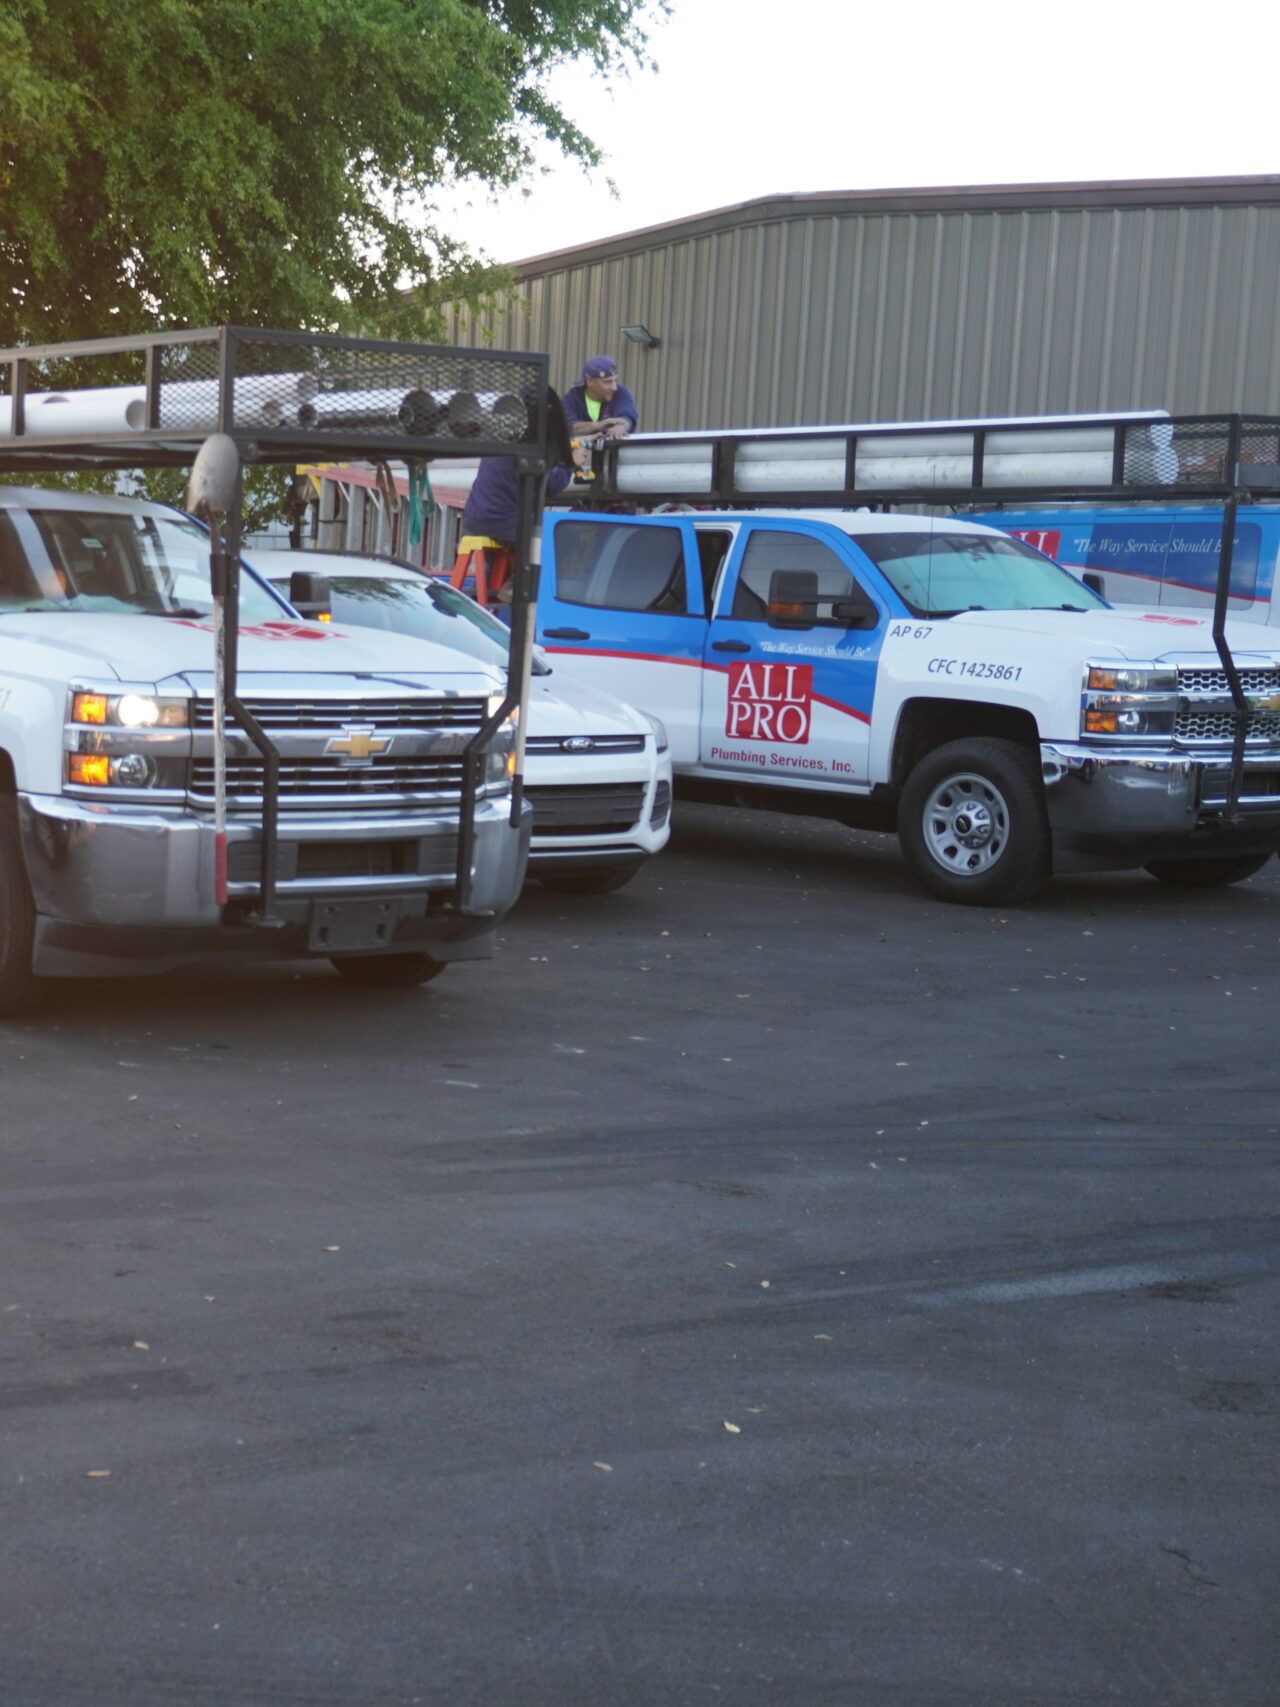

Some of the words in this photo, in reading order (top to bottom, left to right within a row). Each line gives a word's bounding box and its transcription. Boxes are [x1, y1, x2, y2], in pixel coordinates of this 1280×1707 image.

[1099, 538, 1123, 556] Way
[1125, 538, 1168, 553] Service
[1170, 538, 1213, 553] Should
[890, 625, 912, 637] AP
[914, 626, 933, 639] 67
[928, 658, 957, 674] CFC
[960, 662, 1023, 681] 1425861
[732, 663, 806, 702] ALL
[728, 701, 807, 742] PRO
[711, 747, 766, 766] Plumbing
[771, 753, 827, 771] Services,
[832, 760, 855, 773] Inc.
